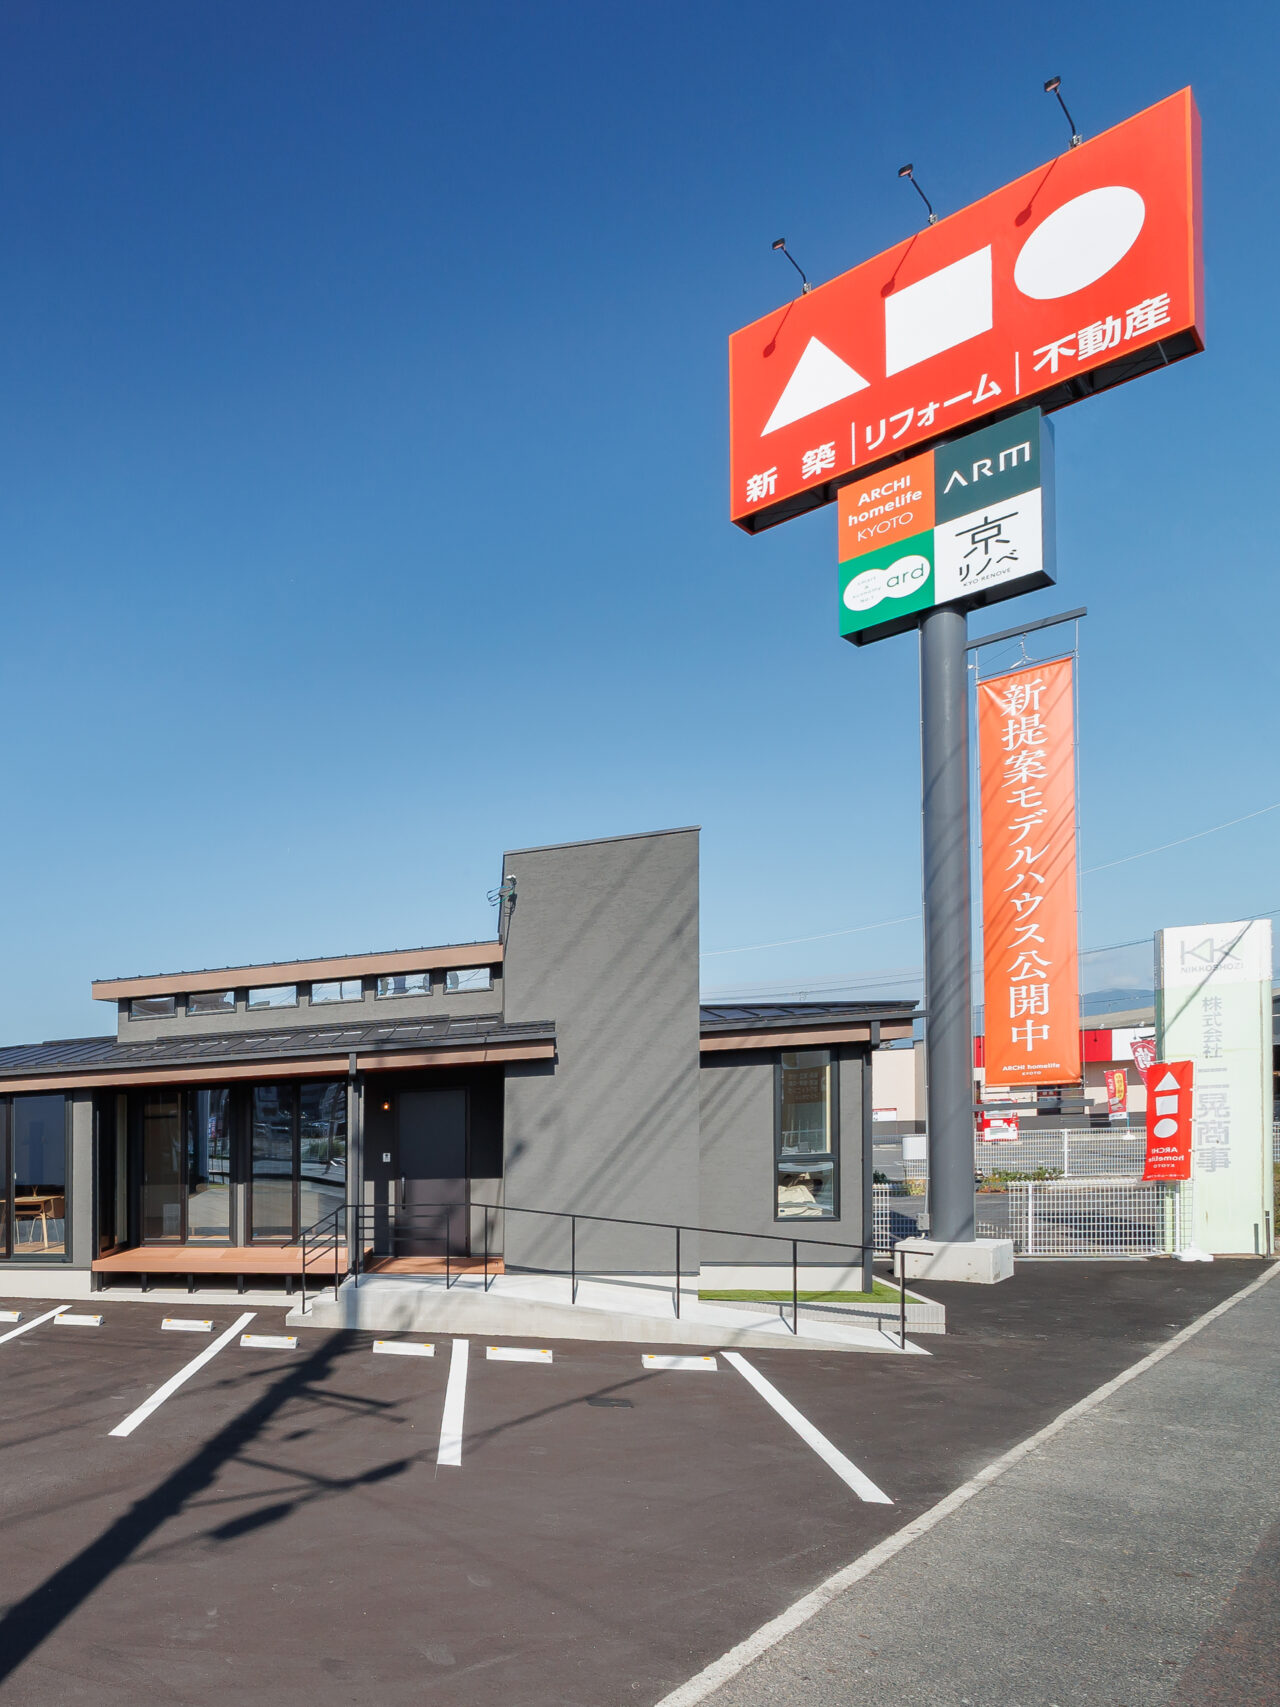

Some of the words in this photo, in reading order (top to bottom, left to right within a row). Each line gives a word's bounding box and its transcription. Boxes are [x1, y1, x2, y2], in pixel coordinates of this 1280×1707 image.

[865, 373, 1002, 449] リフォーム
[1033, 292, 1171, 373] 不動産
[943, 441, 1031, 494] ARM
[857, 475, 911, 506] ARCHI
[848, 489, 923, 527] homelife
[857, 511, 913, 542] KYOTO
[955, 511, 1019, 558] 京
[886, 563, 924, 588] ard
[959, 549, 1019, 582] リノベ
[981, 567, 1011, 581] RENOVE
[999, 677, 1052, 1052] 新提案モデルハウス公開中
[1001, 1064, 1026, 1072] ARCHI
[1027, 1062, 1061, 1070] homelife
